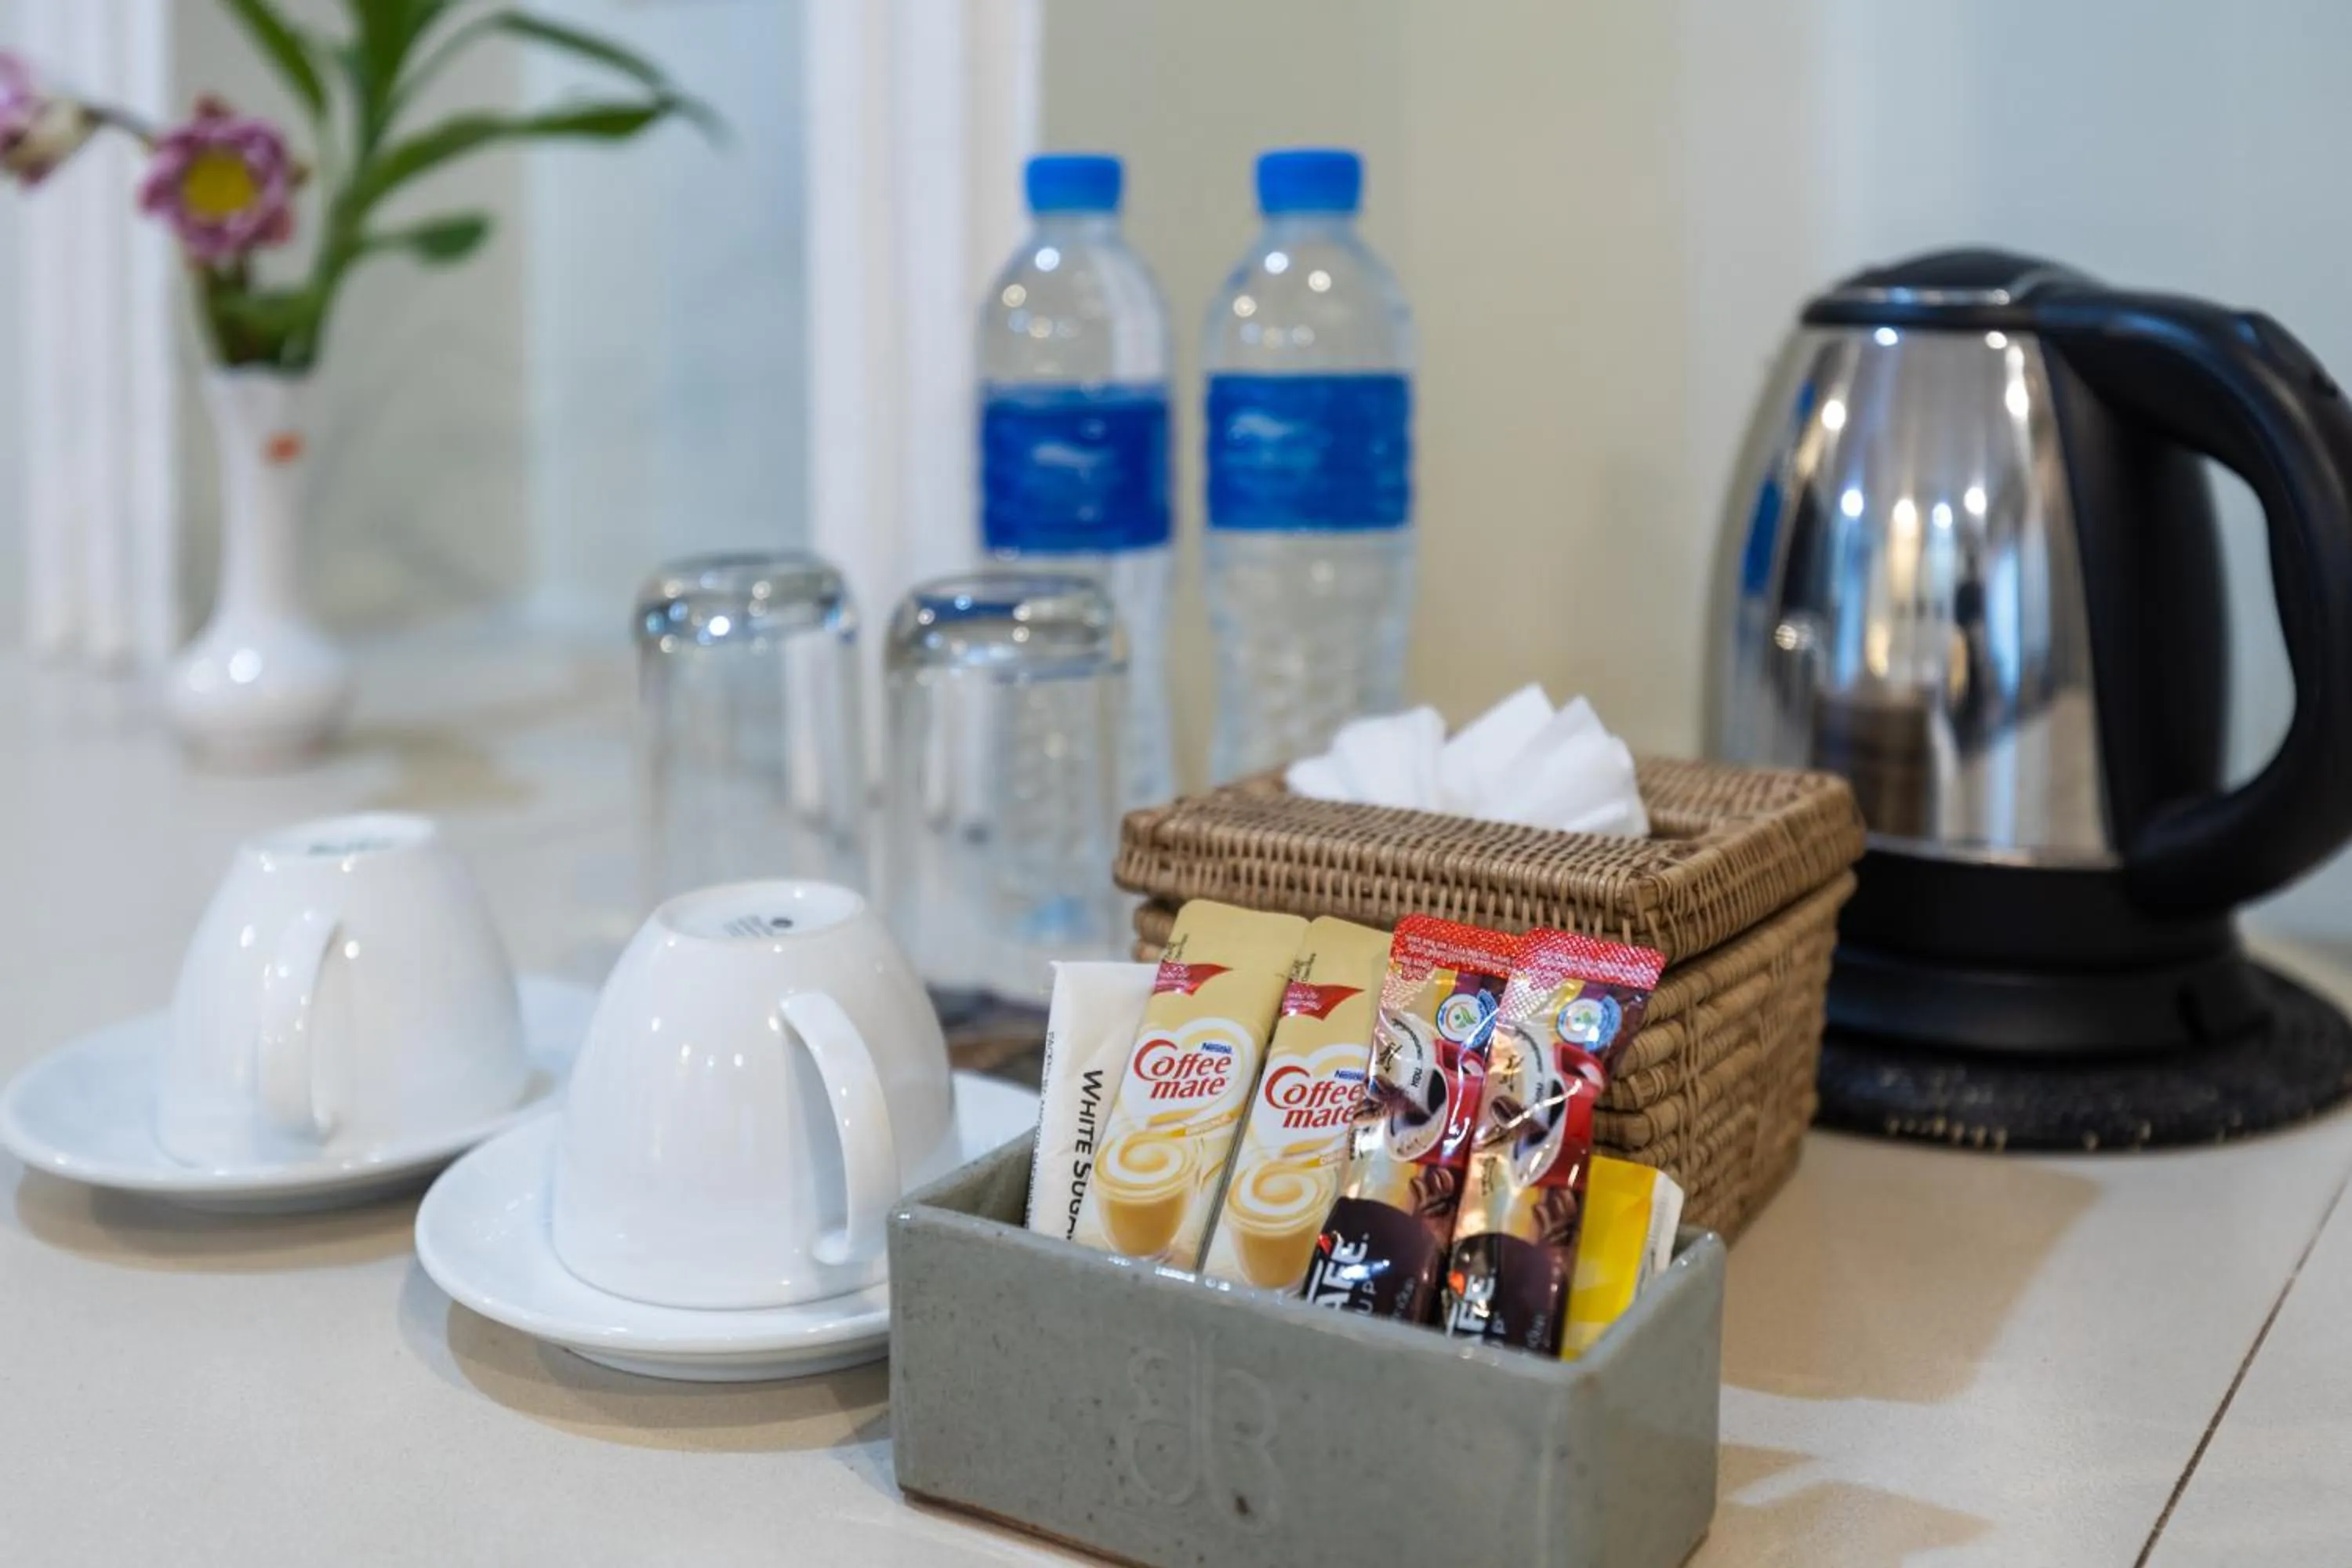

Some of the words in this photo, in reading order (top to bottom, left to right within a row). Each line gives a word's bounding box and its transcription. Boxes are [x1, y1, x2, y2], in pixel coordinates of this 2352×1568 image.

[1133, 1038, 1232, 1081] Coffee
[1149, 1076, 1225, 1099] mate
[1265, 1065, 1364, 1109] Coffee
[1075, 1070, 1103, 1155] WHITE
[1283, 1105, 1356, 1129] mate
